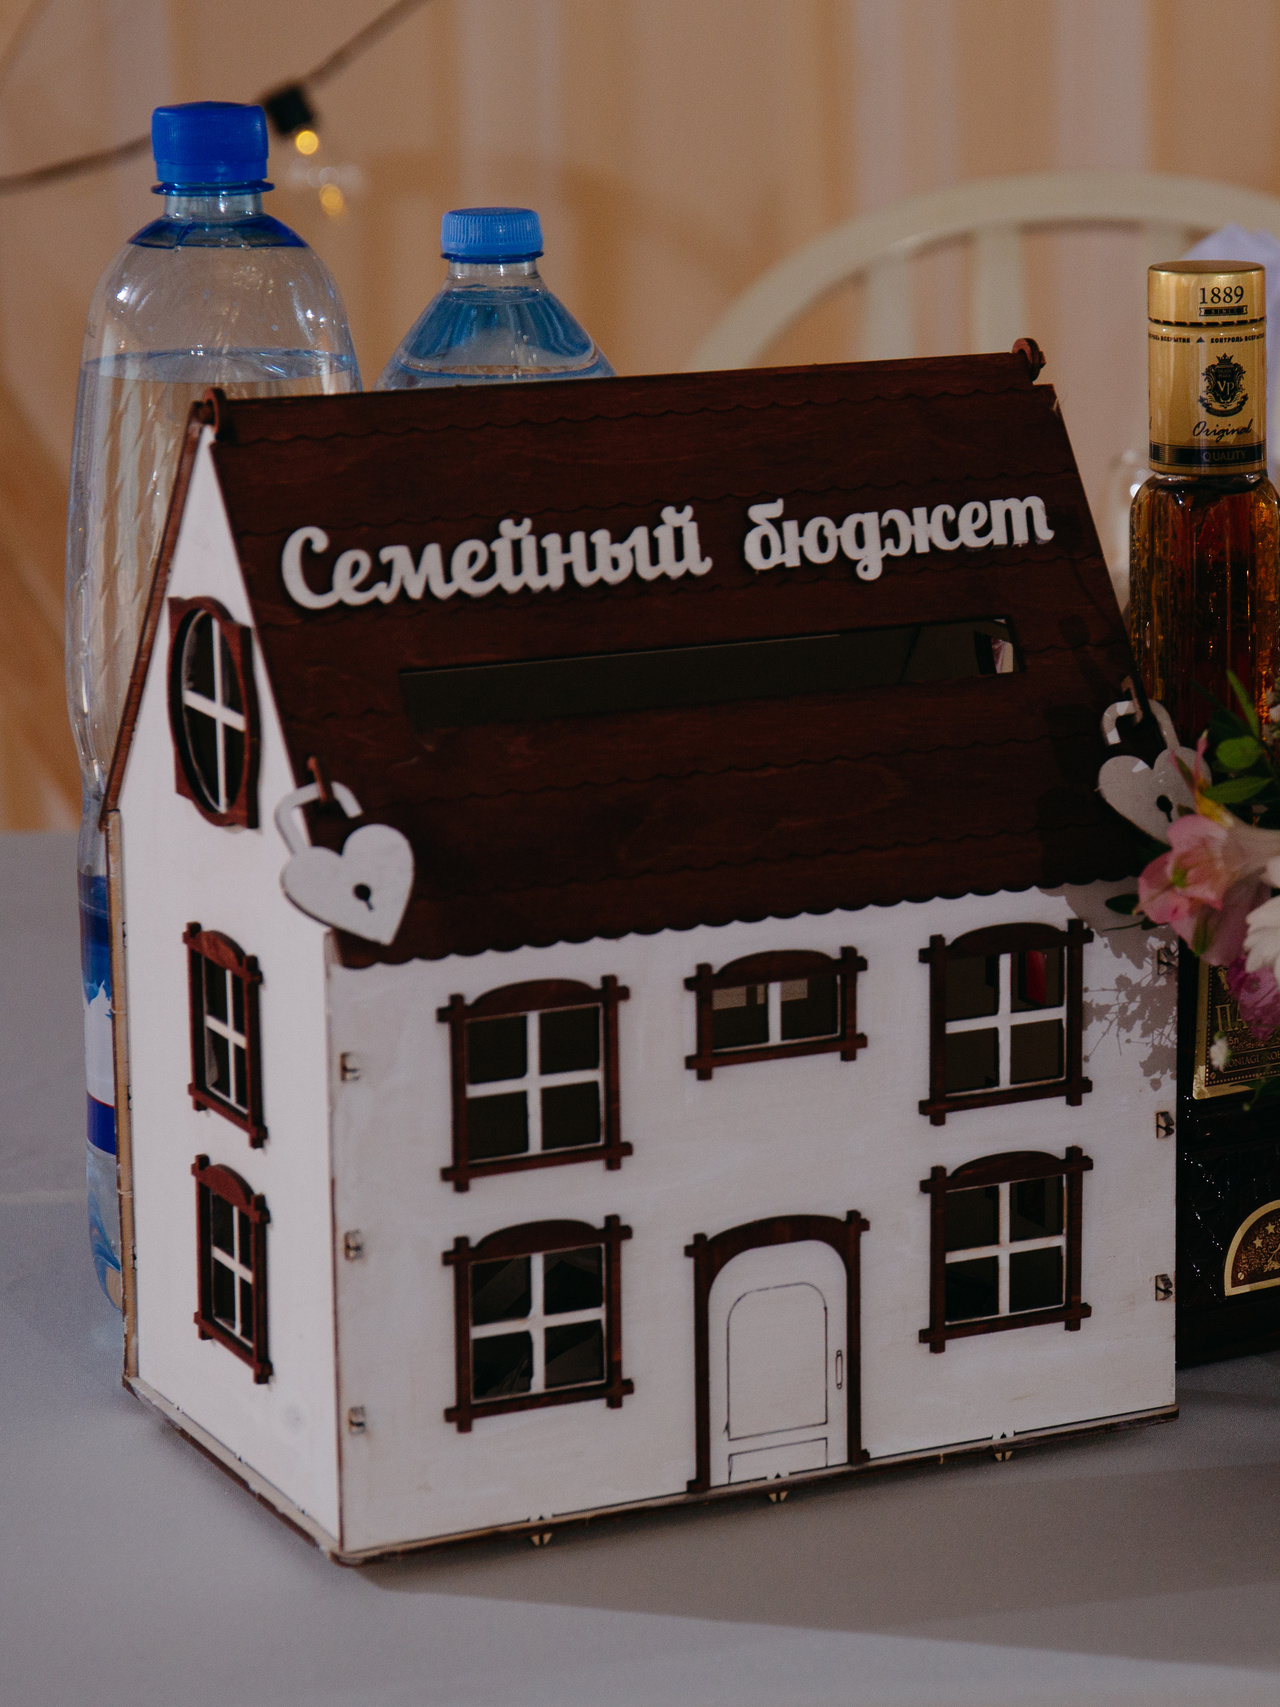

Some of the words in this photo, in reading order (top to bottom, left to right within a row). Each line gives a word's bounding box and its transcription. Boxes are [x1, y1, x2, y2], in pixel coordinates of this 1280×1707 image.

[1200, 285, 1244, 304] 1889
[1211, 336, 1243, 344] КОНТРОЛЬ
[1217, 380, 1235, 396] VP
[1193, 418, 1253, 443] Original
[1203, 450, 1245, 463] QUALITY
[280, 505, 712, 611] Семейный
[744, 495, 1056, 581] бюджет
